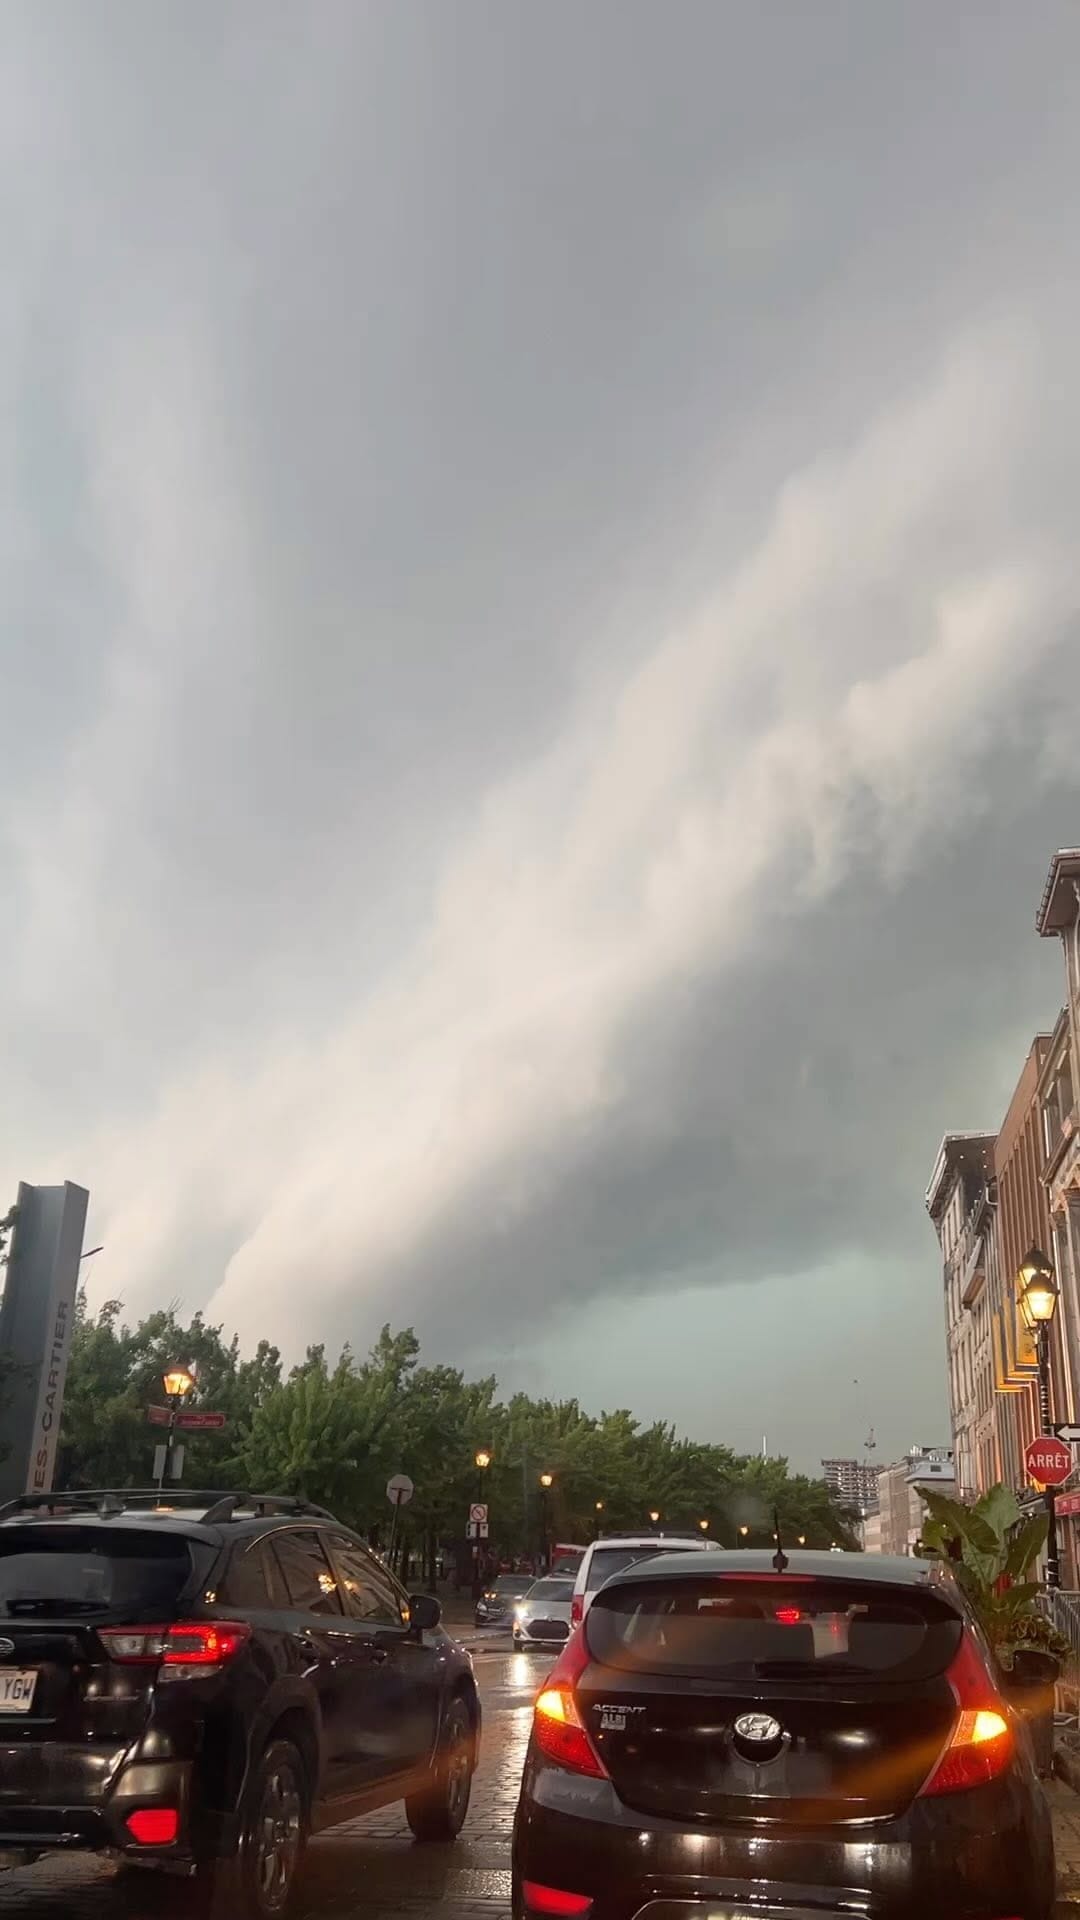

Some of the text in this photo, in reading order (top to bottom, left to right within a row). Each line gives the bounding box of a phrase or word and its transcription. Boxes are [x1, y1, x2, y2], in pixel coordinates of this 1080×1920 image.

[31, 1301, 67, 1493] ES-CARTIER
[1028, 1452, 1069, 1468] ARRÊT
[4, 1679, 34, 1700] YGW
[592, 1704, 647, 1713] ACCENT
